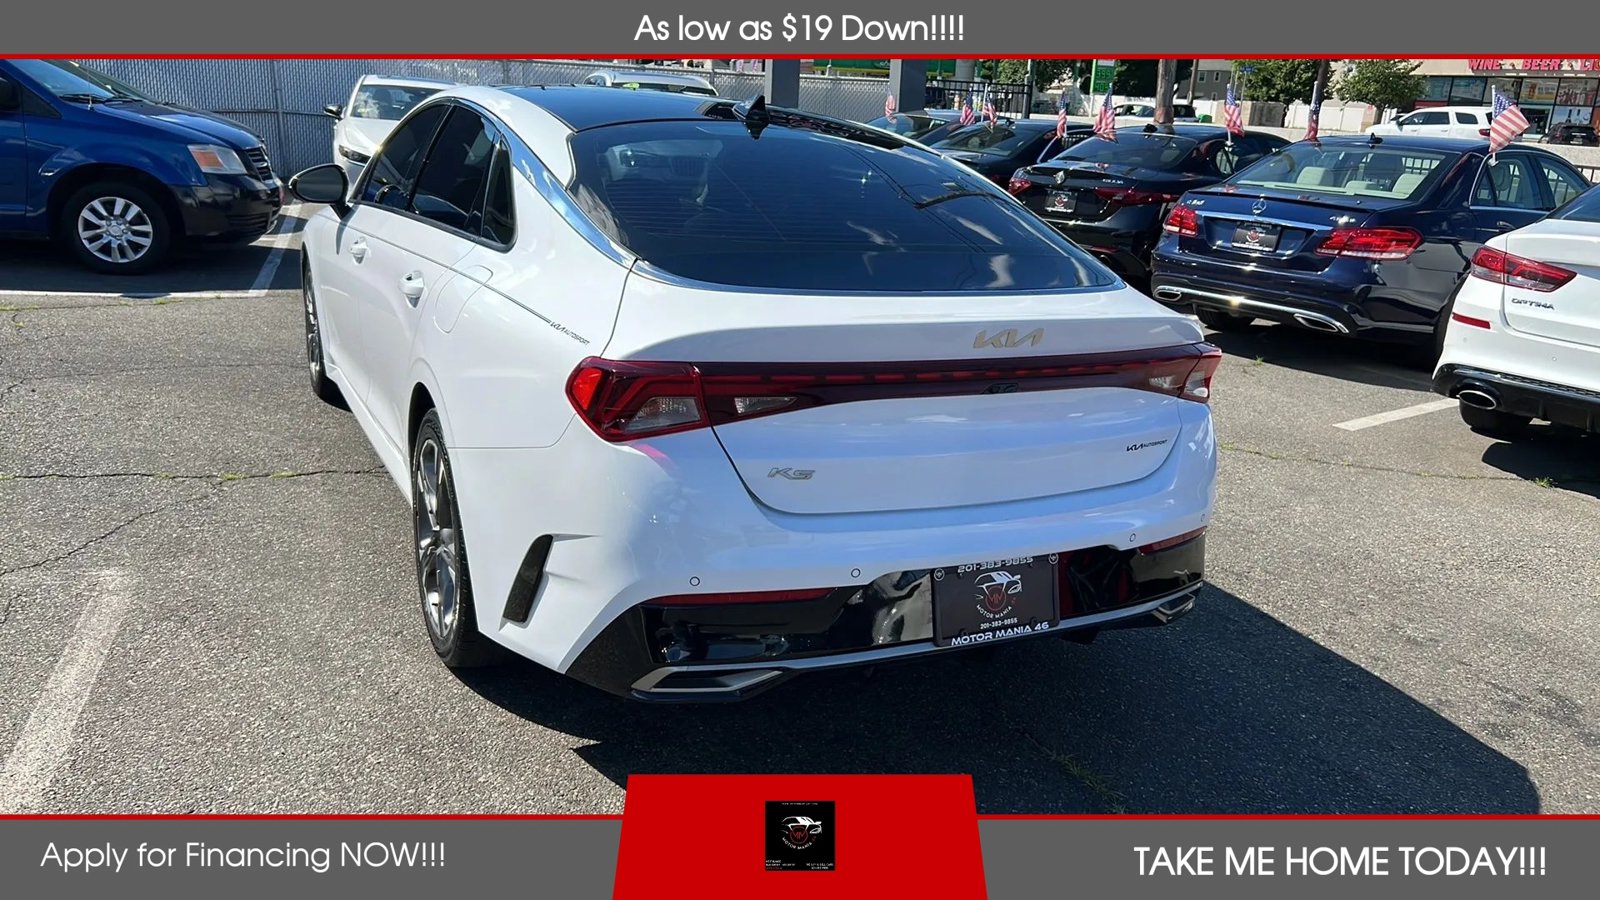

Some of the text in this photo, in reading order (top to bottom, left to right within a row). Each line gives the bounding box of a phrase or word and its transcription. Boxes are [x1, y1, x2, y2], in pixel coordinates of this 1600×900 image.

[1468, 59, 1501, 70] WINE
[1521, 59, 1561, 71] BEER
[1511, 298, 1555, 310] OPTIMA
[972, 328, 1045, 349] KIA
[767, 466, 817, 481] K5
[976, 604, 1012, 619] MOTOR MANIA
[951, 621, 1049, 646] MOTOR MANIA 46
